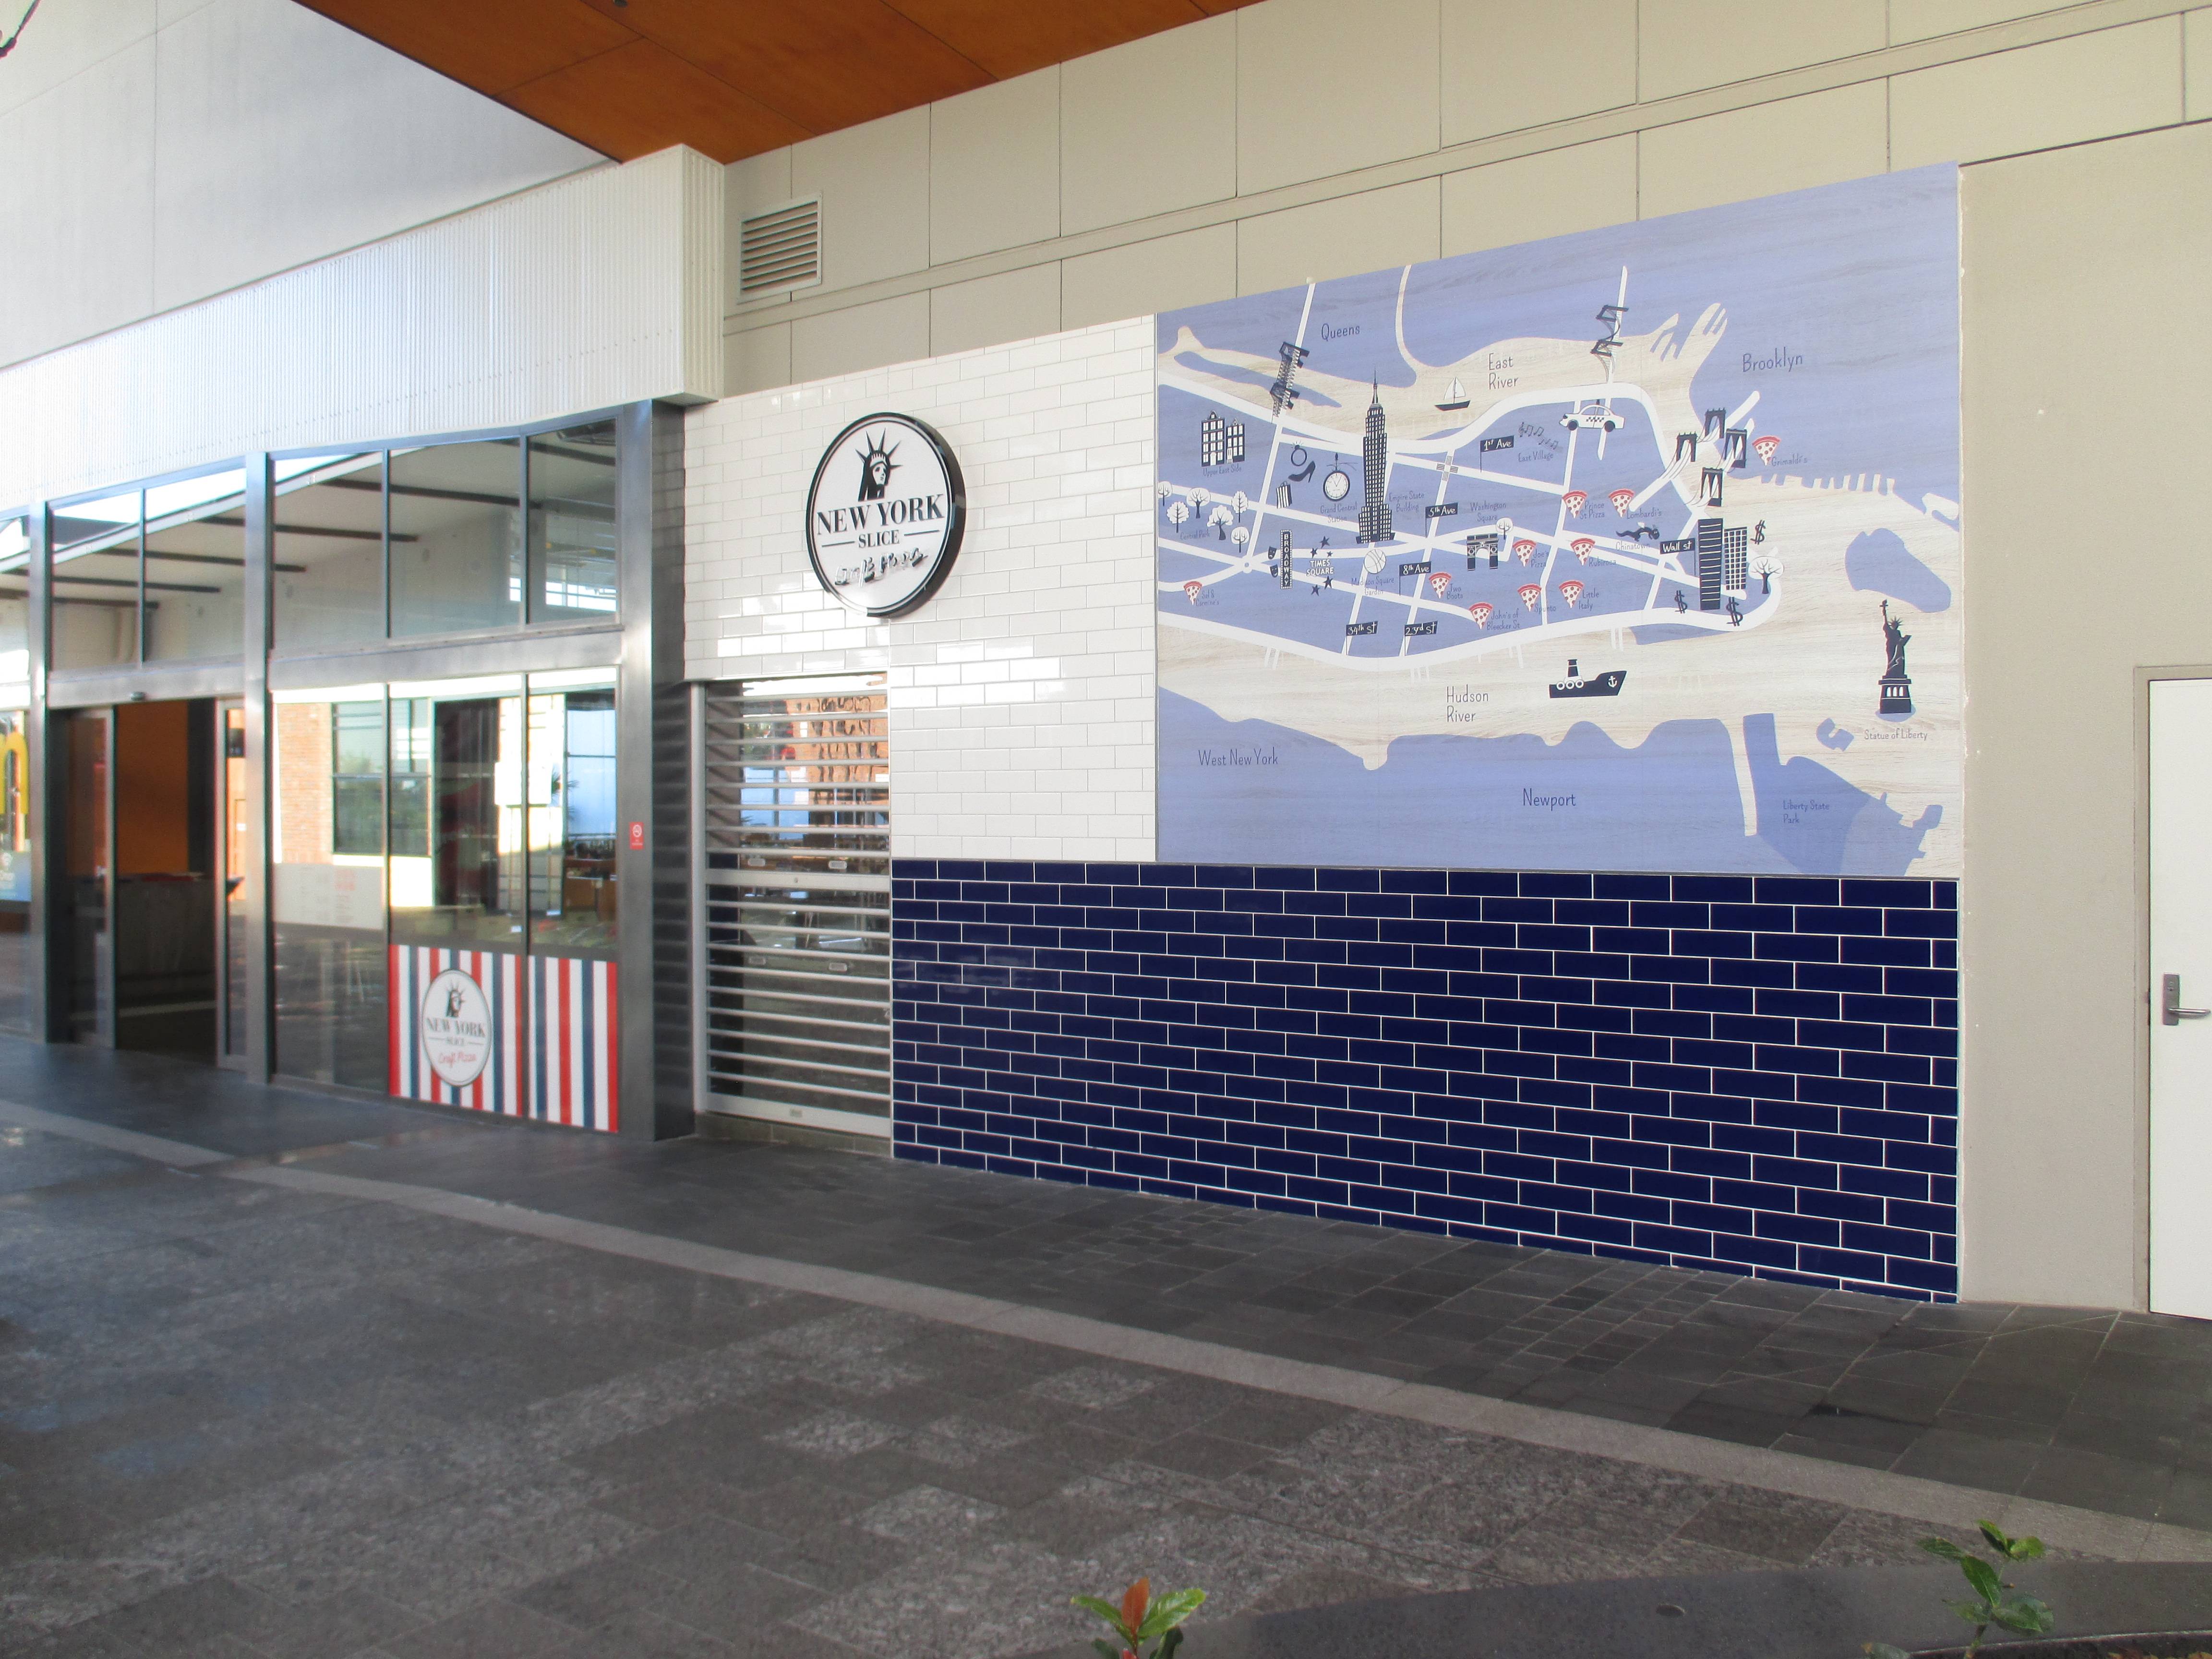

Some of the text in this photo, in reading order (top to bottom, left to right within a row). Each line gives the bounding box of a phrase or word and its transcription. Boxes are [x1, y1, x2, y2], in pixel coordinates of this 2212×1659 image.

[1321, 323, 1360, 341] Queens
[1489, 353, 1514, 371] East
[1743, 347, 1803, 373] Brooklyn
[1489, 373, 1519, 390] River
[1484, 439, 1512, 451] 1st Ave
[1518, 449, 1553, 462] East Village
[1203, 463, 1241, 478] Upper East Side
[1389, 490, 1424, 502] Empire State
[1320, 500, 1357, 514] Grand Central
[1396, 502, 1419, 513] Building
[1470, 500, 1506, 511] Washington
[1585, 501, 1605, 509] Prince
[817, 494, 945, 535] NEW YORK
[1428, 506, 1456, 517] 5th Ave
[1580, 509, 1605, 519] St Pizza
[1626, 507, 1662, 519] Lombardi's
[1327, 514, 1347, 523] Station
[1477, 512, 1498, 523] Square
[858, 530, 901, 549] SLICE
[1180, 529, 1210, 540] Central Park
[1616, 541, 1649, 551] Chinatown
[1662, 541, 1680, 552] Wall
[1533, 549, 1549, 558] Joe's
[1310, 559, 1330, 567] TIMES
[1531, 559, 1546, 568] Pizza
[1588, 556, 1617, 567] Rubirosa
[1306, 567, 1334, 576] SQUARE
[1403, 564, 1430, 575] 8th Ave
[1351, 576, 1395, 586] Madison Square
[1364, 586, 1383, 596] Garden
[1450, 584, 1461, 592] Two
[1582, 588, 1599, 599] Little
[1202, 589, 1210, 599] Sal
[1447, 591, 1463, 600] Boots
[1196, 599, 1220, 607] Carmine's
[1534, 603, 1556, 614] Spunto
[1579, 599, 1593, 611] Italy
[1491, 608, 1519, 620] John's of
[1347, 624, 1364, 635] 34th
[1406, 623, 1423, 635] 23rd
[1487, 619, 1520, 630] Bleecker St
[1447, 685, 1489, 703] Hudson
[1447, 706, 1476, 722] River
[1864, 728, 1927, 741] Statue of Liberty
[1198, 746, 1278, 766] West New York
[1523, 788, 1576, 811] Newport
[1783, 800, 1829, 812] Liberty State
[1783, 814, 1800, 823] Park
[425, 1017, 485, 1037] NEW YORK
